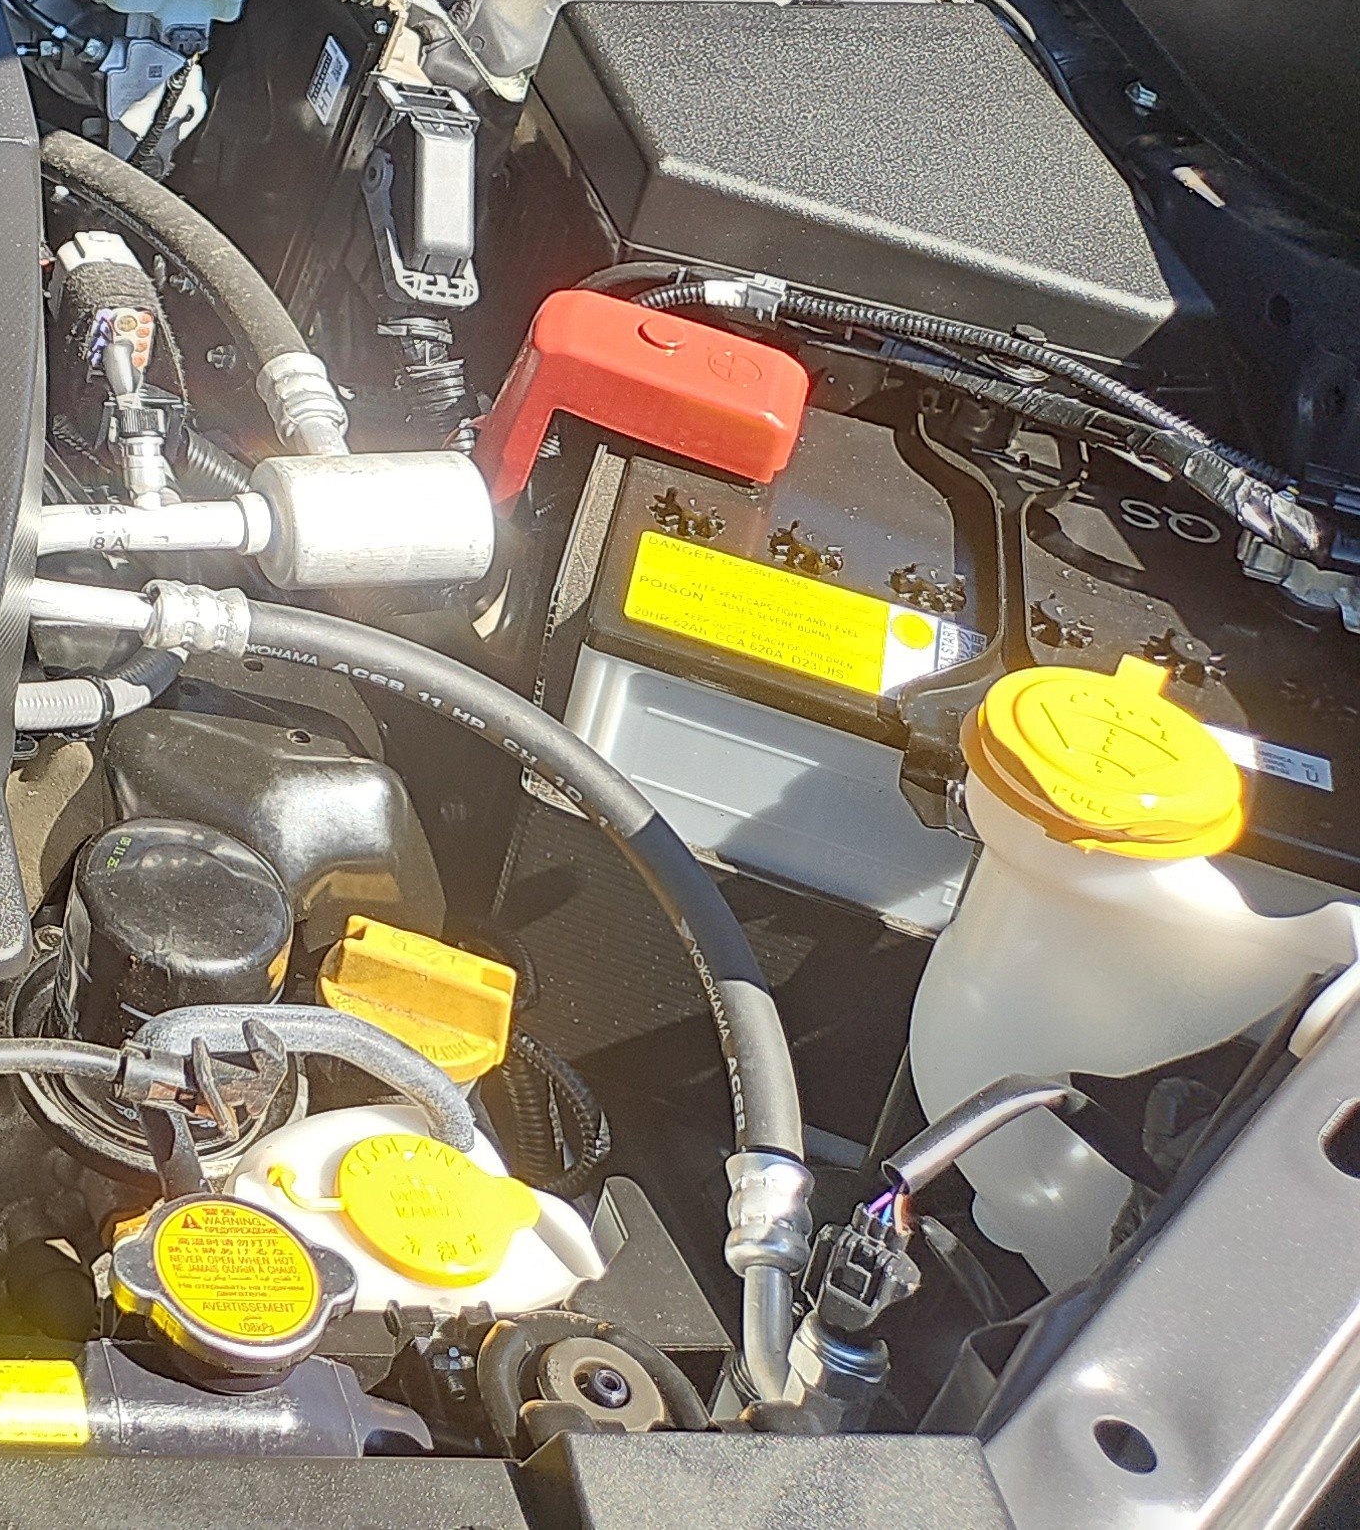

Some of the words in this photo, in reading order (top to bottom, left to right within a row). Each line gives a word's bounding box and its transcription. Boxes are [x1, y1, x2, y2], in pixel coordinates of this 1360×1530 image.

[649, 536, 715, 562] DANGER
[639, 575, 704, 602] POISON
[715, 631, 745, 648] CCA
[451, 707, 486, 730] HP
[689, 937, 730, 1042] YOKOHAMA
[169, 1255, 203, 1264] NEVER
[207, 1255, 235, 1264] OPEN
[239, 1256, 270, 1265] WHEN
[202, 1301, 295, 1312] AVERTISSEMENT
